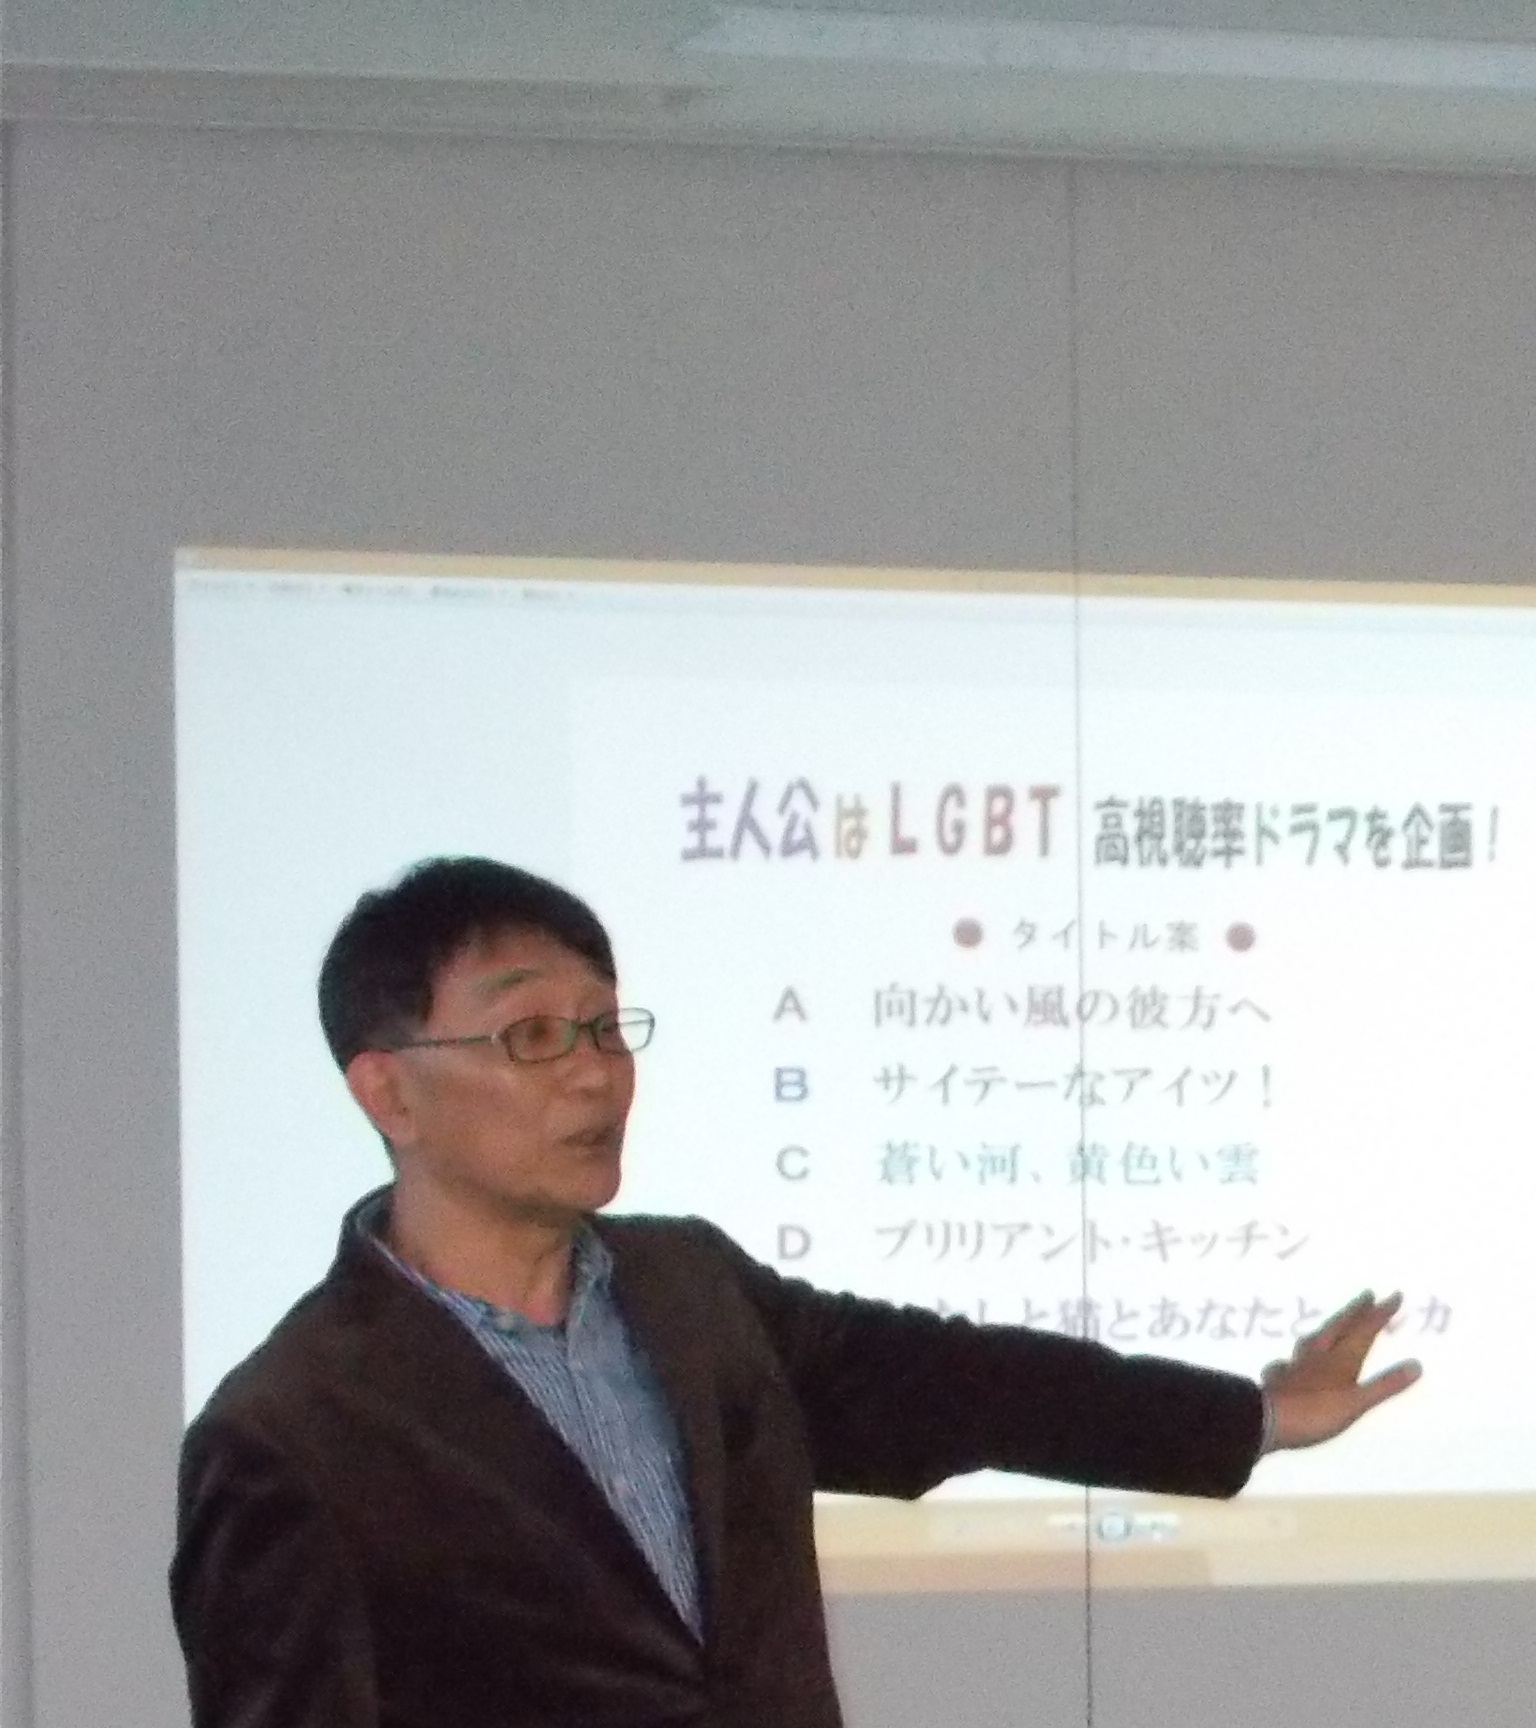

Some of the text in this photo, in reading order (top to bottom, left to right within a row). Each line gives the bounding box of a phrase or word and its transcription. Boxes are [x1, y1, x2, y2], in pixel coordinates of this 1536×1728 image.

[772, 982, 1273, 1030] A 向かい風の彼方へ
[773, 1066, 811, 1104] B
[774, 1143, 811, 1184] C
[777, 1223, 813, 1263] D
